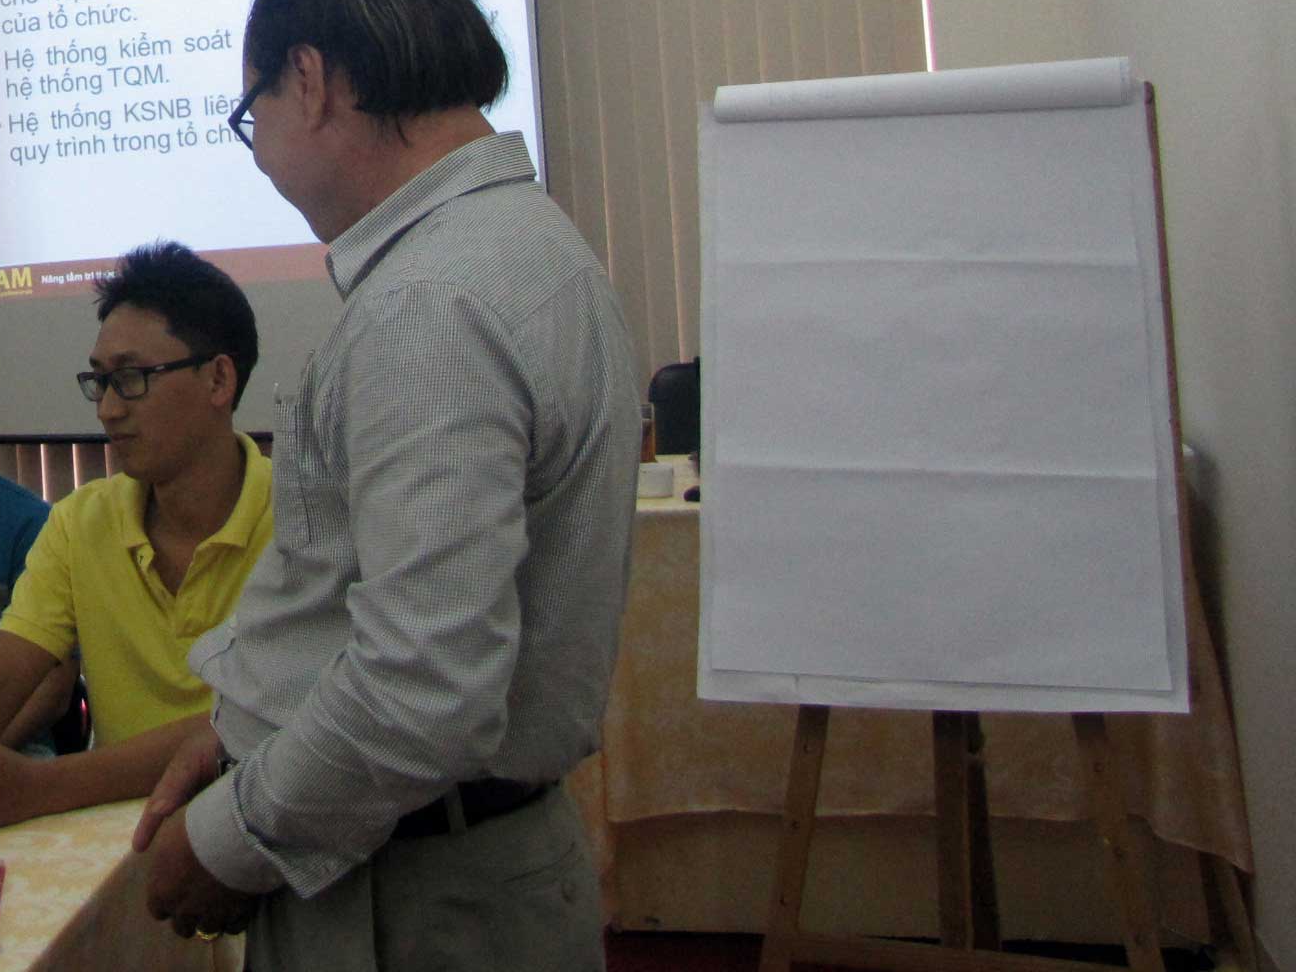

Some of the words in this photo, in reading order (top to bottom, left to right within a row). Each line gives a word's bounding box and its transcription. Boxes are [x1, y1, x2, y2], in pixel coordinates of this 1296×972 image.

[1, 13, 42, 35] của
[48, 3, 70, 31] tổ
[4, 49, 36, 74] Hệ
[46, 39, 108, 70] thống
[119, 31, 173, 60] kiểm
[184, 25, 233, 53] soát
[5, 74, 33, 100] hệ
[40, 64, 104, 96] thống
[107, 62, 171, 89] TQM.
[8, 111, 40, 137] Hệ
[50, 102, 112, 133] thống
[124, 97, 193, 124] KSNB
[9, 138, 49, 167] quy
[56, 129, 106, 157] trình
[113, 129, 172, 158] trong
[177, 121, 198, 147] tổ
